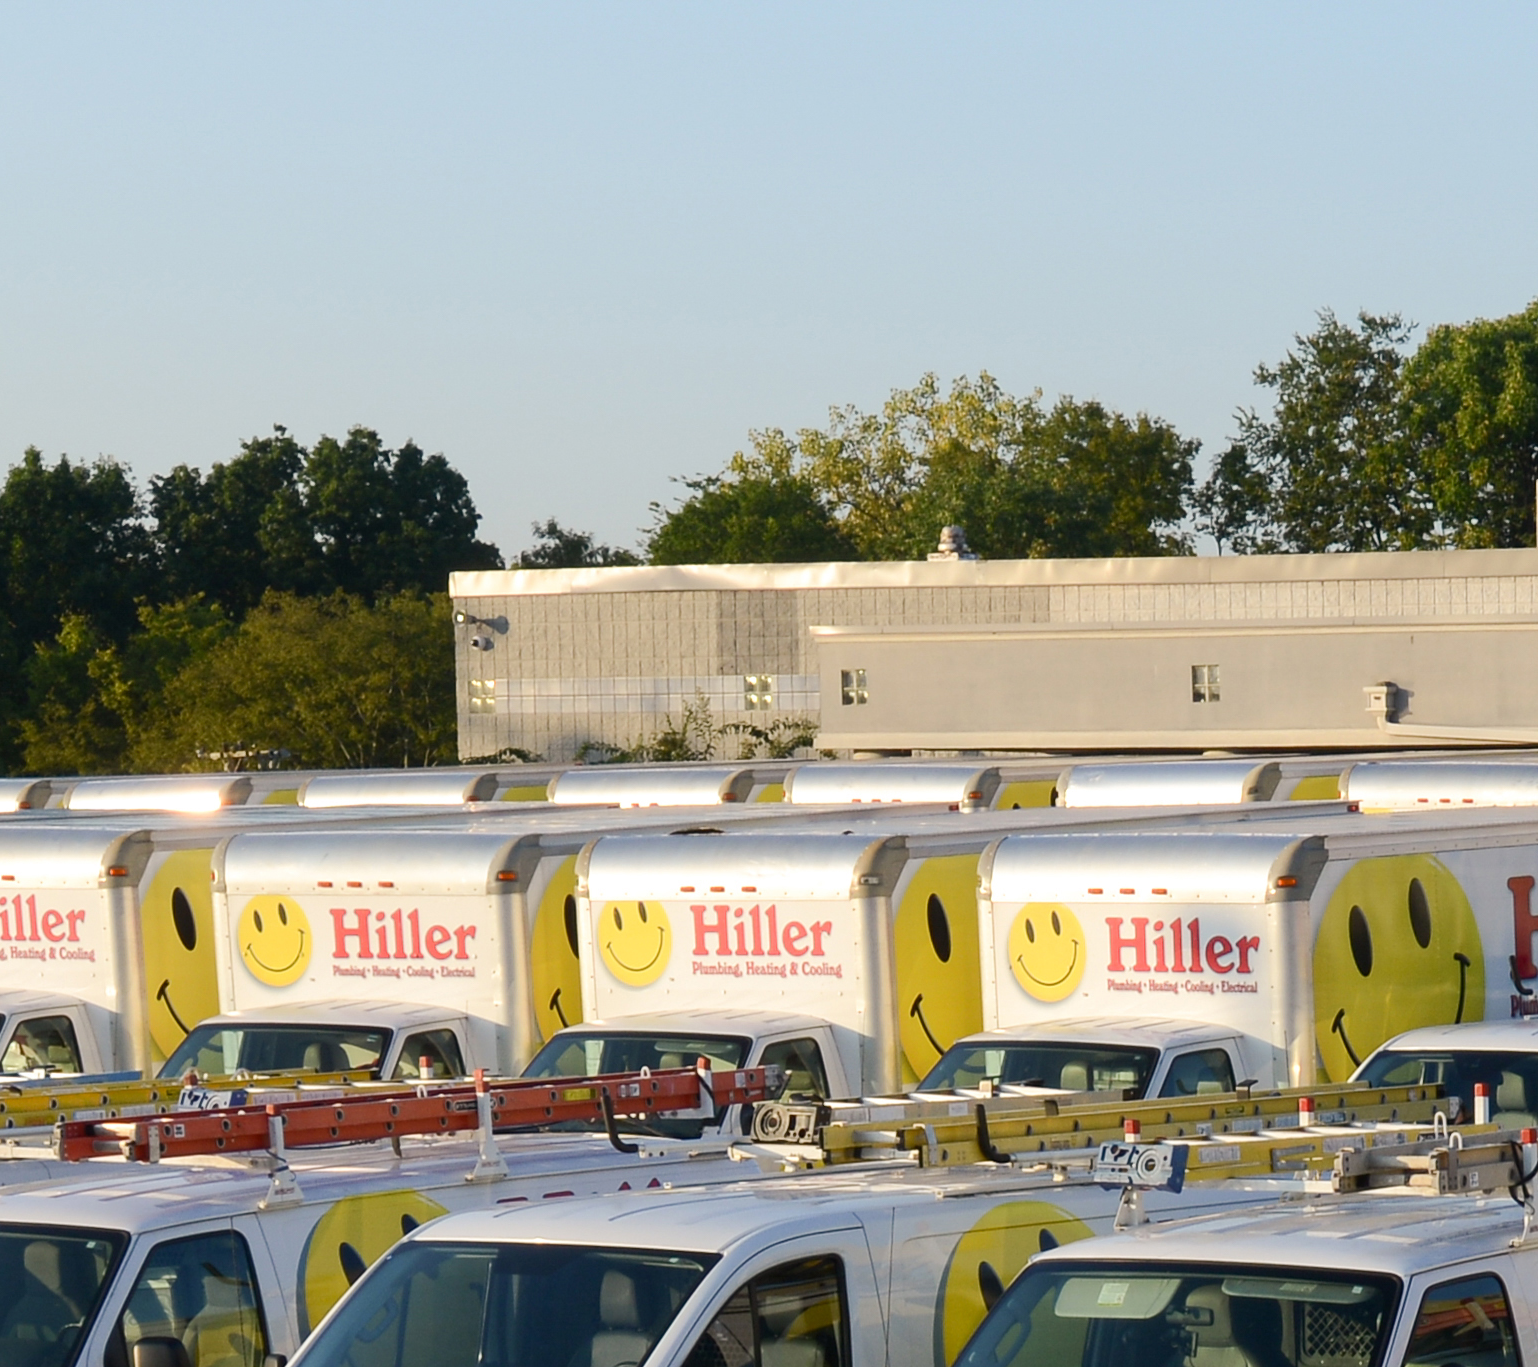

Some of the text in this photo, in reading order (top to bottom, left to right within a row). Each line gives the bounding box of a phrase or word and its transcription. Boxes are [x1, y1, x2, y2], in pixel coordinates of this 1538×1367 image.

[329, 908, 477, 960] Hiller
[690, 903, 833, 957] Hiller
[10, 945, 47, 961] Heating
[48, 946, 56, 959] &
[62, 946, 96, 962] Cooling
[1105, 916, 1261, 975] Hiller
[332, 965, 476, 979] Plumbing Heating Cooling Electrical
[692, 962, 843, 979] Plumbing, Heating & Cooling
[1107, 979, 1258, 994] Plumbing Heating Cooling Electrical
